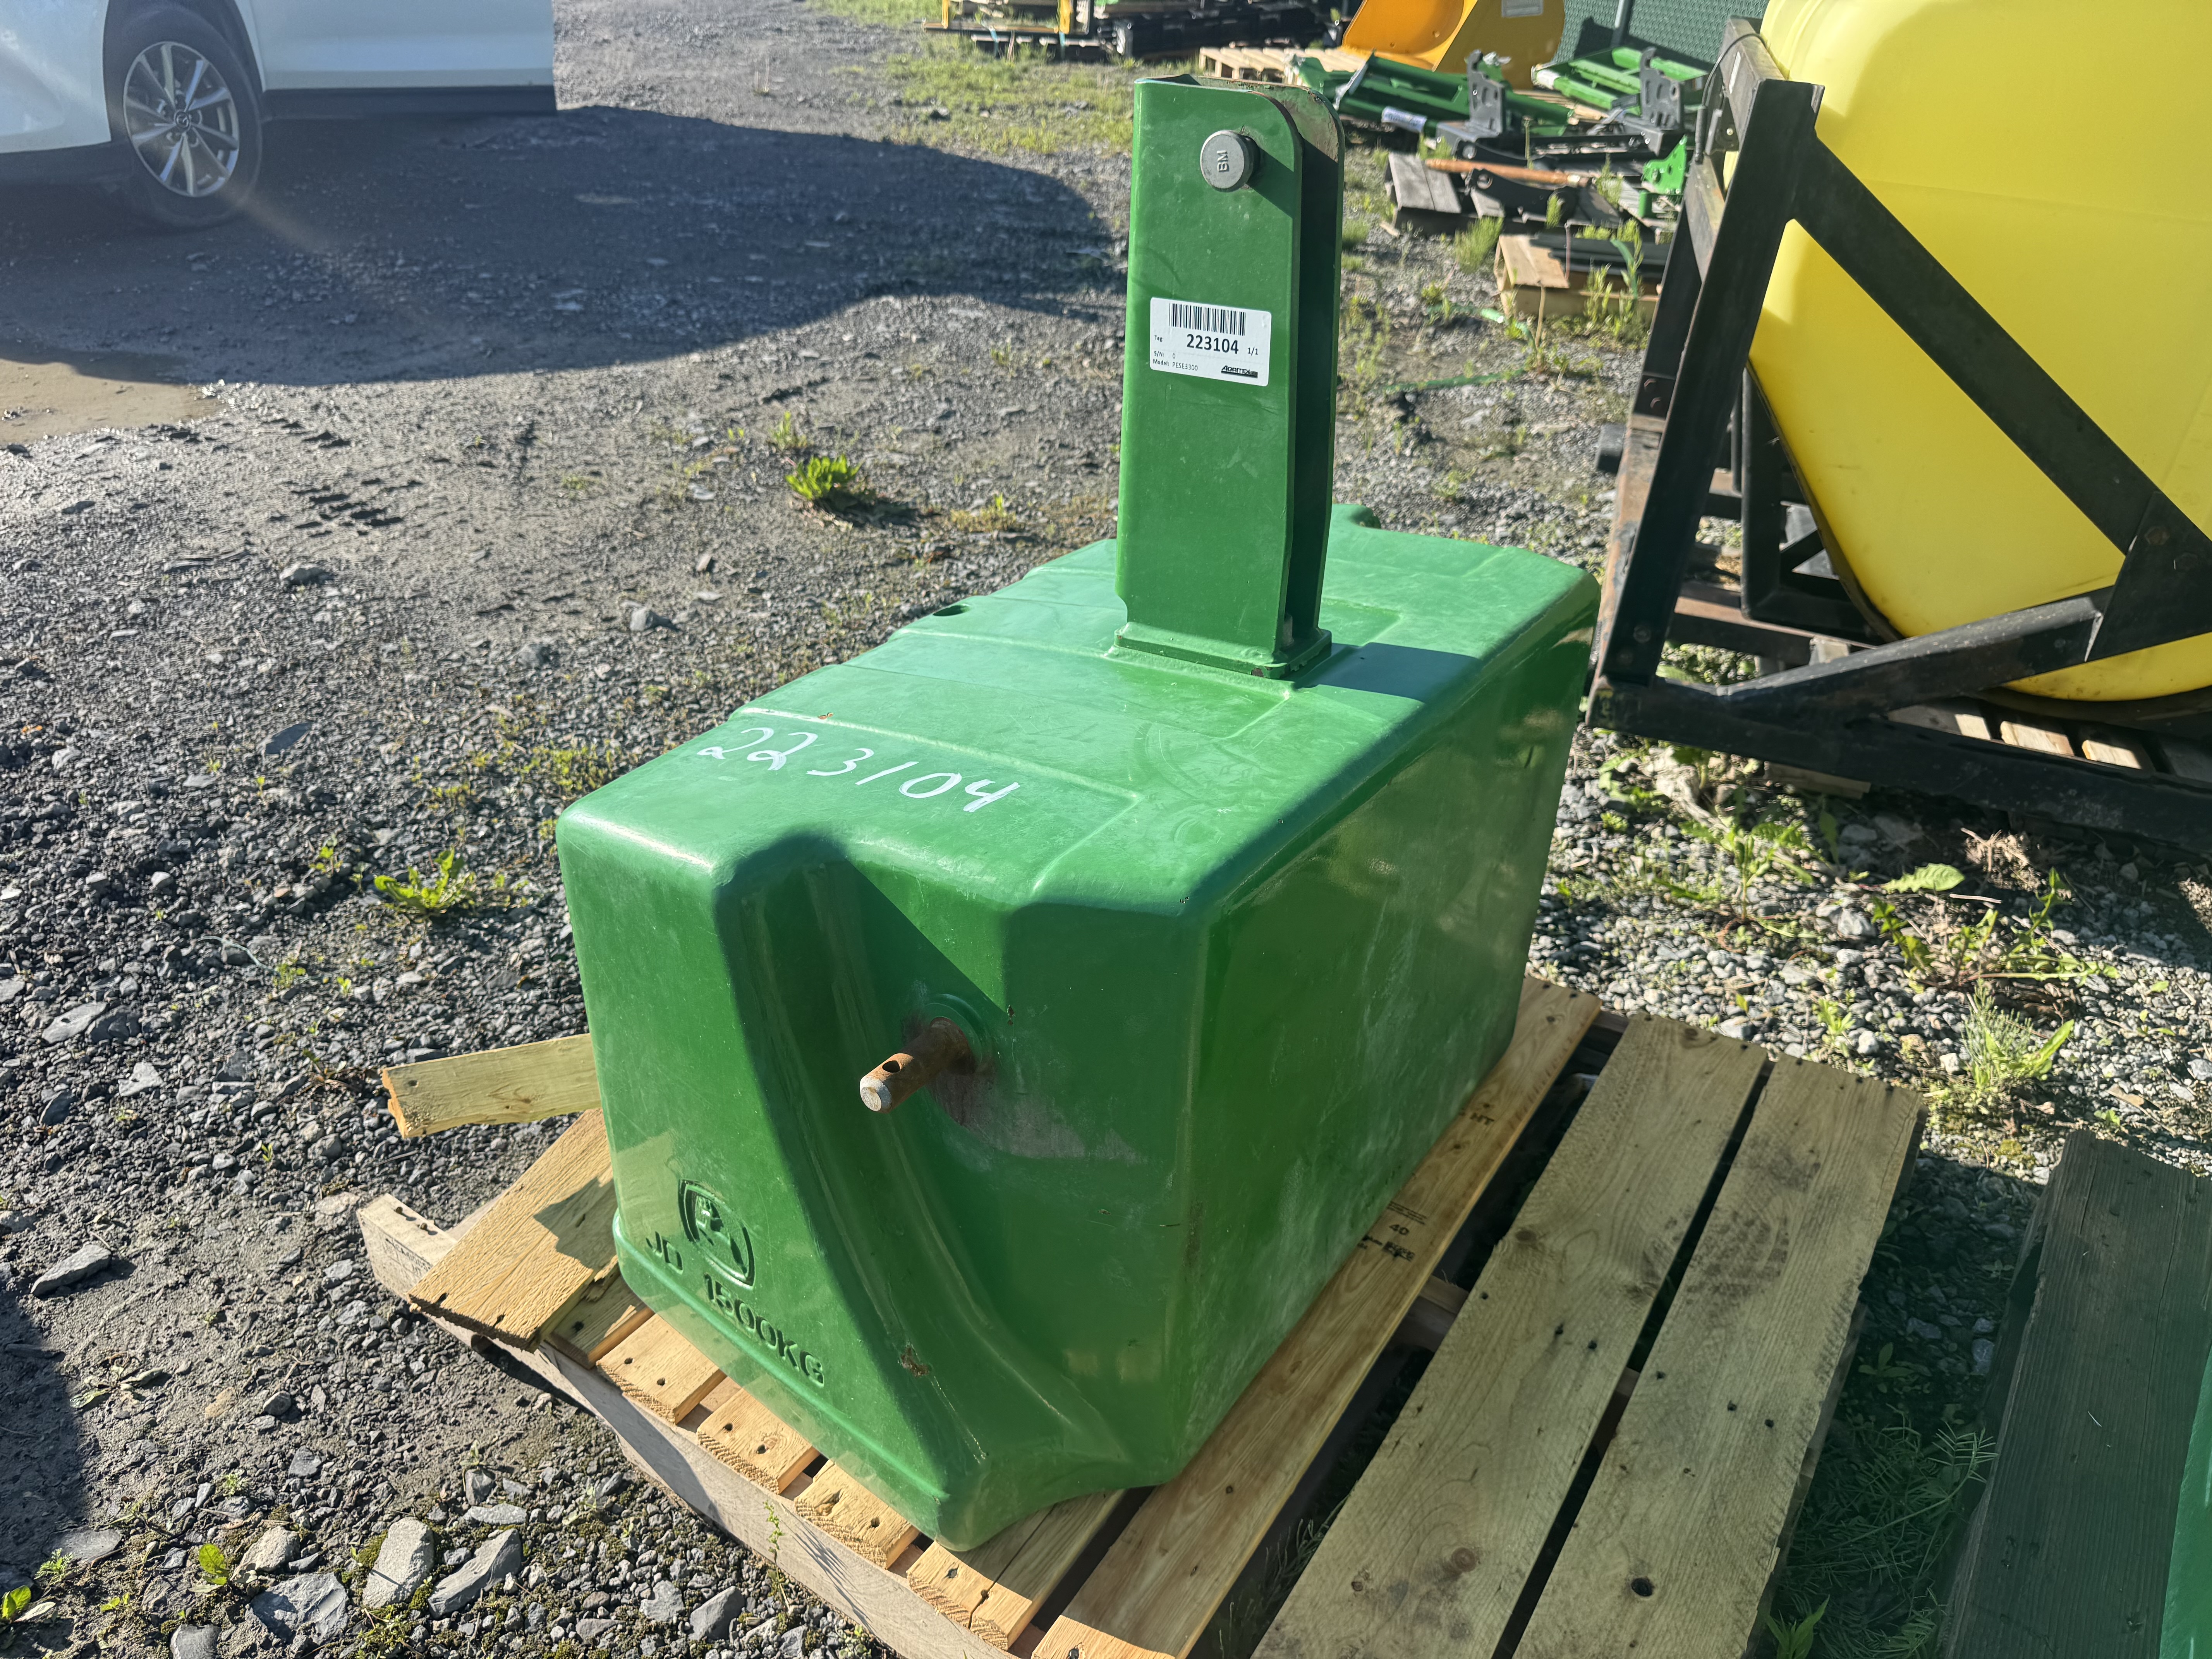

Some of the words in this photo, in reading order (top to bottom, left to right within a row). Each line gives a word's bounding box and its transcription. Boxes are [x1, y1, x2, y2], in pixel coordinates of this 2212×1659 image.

[1217, 150, 1229, 172] BM
[1187, 333, 1239, 354] 223104
[1247, 347, 1258, 356] 1/1
[697, 727, 1021, 813] 223104
[646, 1231, 684, 1275] JD
[704, 1273, 824, 1388] 1500KG
